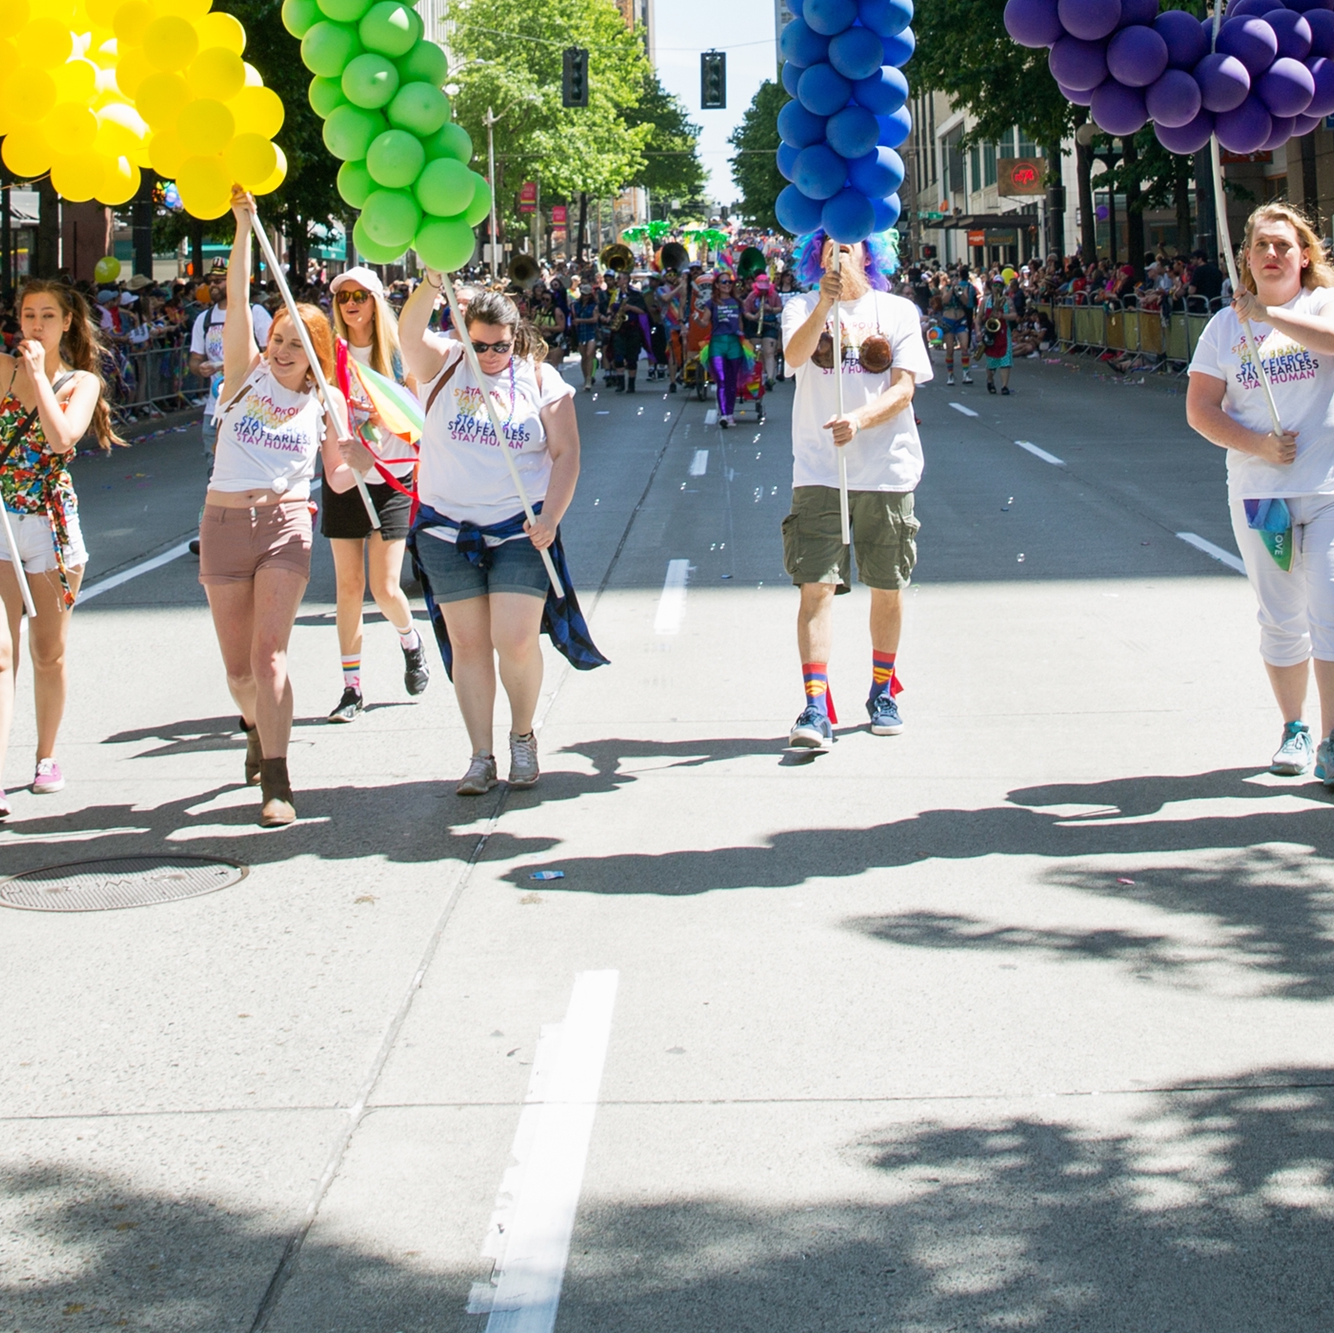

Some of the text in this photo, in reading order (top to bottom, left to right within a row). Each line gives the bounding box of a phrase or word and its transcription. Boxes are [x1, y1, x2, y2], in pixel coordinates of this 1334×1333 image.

[1240, 334, 1266, 344] SAY
[1269, 345, 1307, 358] BRAVE
[1269, 351, 1310, 367] FIERCE
[823, 367, 845, 375] STY
[1242, 369, 1316, 390] STA HUMAN
[466, 386, 482, 396] STA
[234, 422, 311, 445] STAY FEARLESS
[447, 421, 531, 442] STAY FEALESS
[451, 430, 477, 443] STAY
[237, 432, 307, 454] STAY HUMAN
[1275, 533, 1284, 556] OVE
